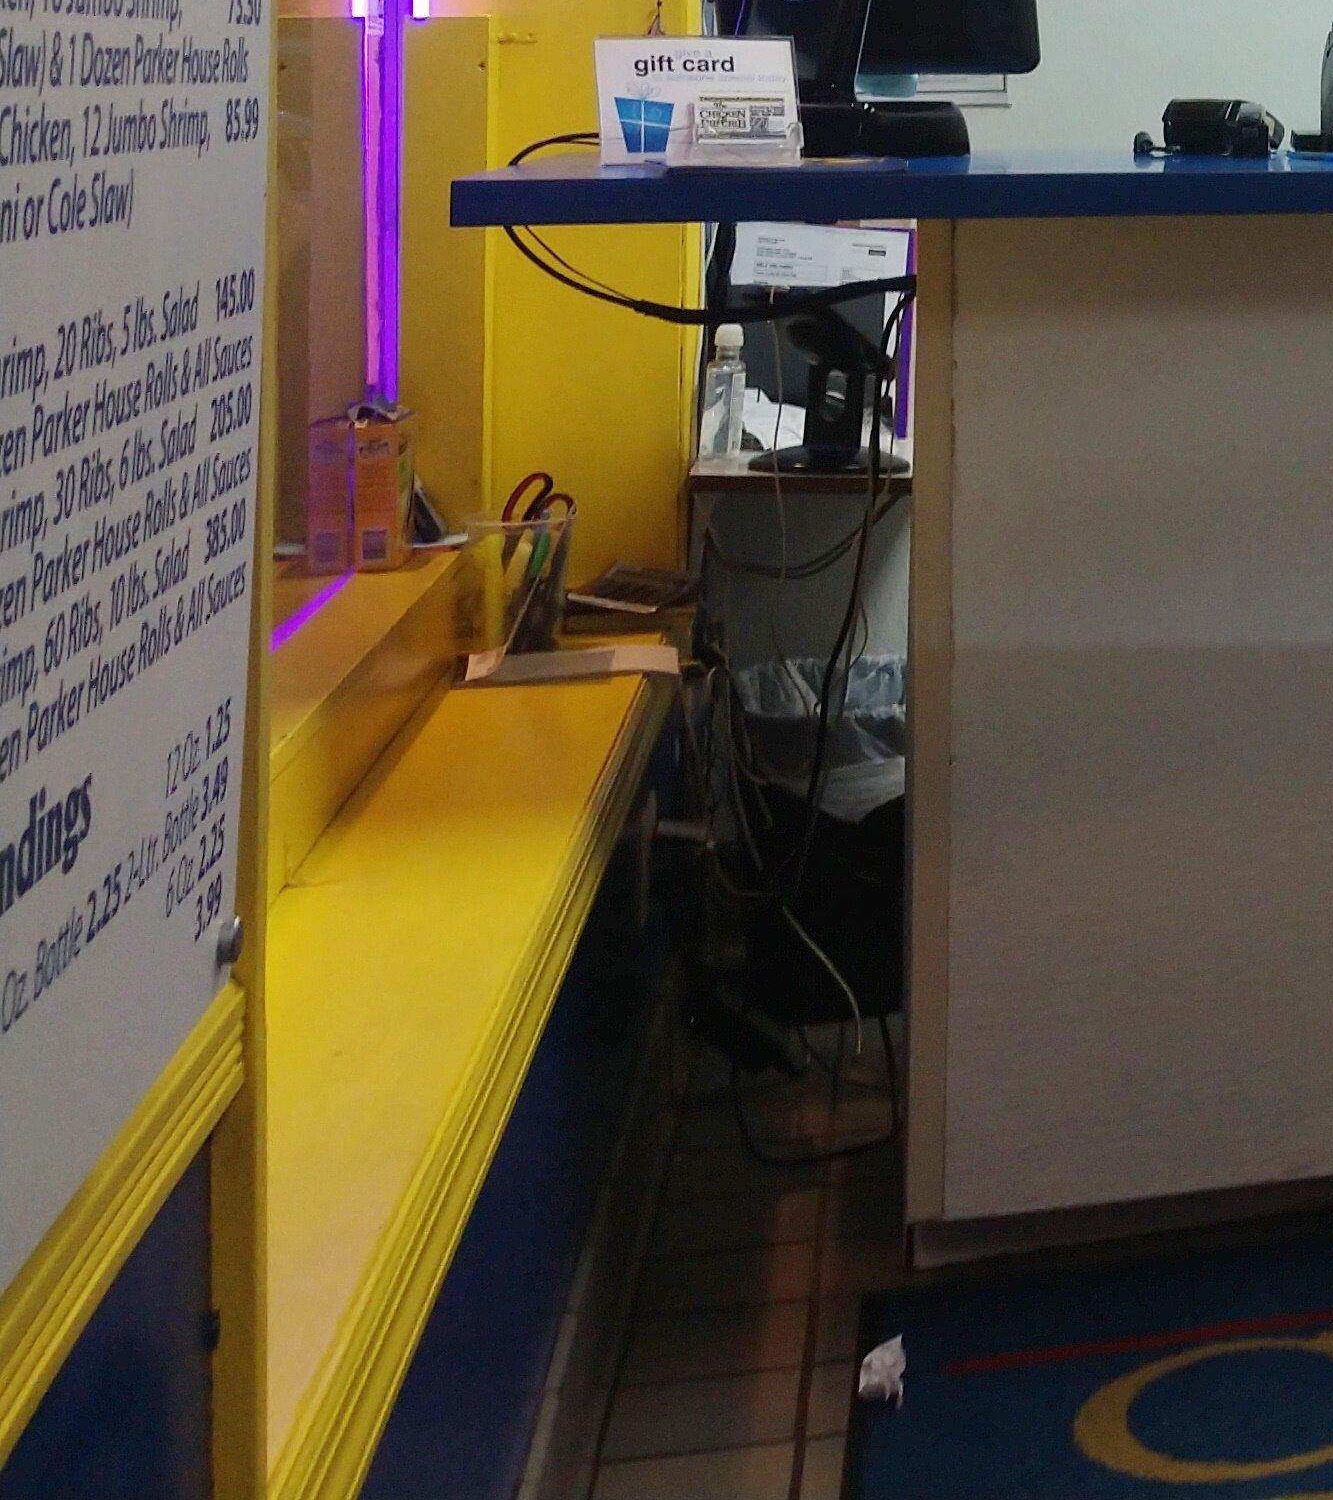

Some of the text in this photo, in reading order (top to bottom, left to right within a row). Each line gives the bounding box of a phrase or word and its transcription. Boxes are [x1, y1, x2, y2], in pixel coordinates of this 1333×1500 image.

[80, 31, 250, 87] Dozen Parker House Rolls
[634, 55, 736, 76] gift card
[0, 96, 260, 168] Chicken, 12 Jumbo Shrimp, 85.99
[23, 167, 135, 240] or Cole Slaw)
[53, 320, 77, 381] 20
[79, 308, 117, 370] Ribs,
[121, 304, 132, 357] 5
[161, 279, 200, 342] Salad
[215, 267, 255, 323] 145.00
[210, 382, 252, 443] 205.00
[204, 497, 247, 565] 385.00
[205, 697, 232, 760] 1.25
[201, 755, 229, 822] 3.49
[86, 861, 124, 945] 2.25
[34, 904, 84, 1003] Bottle
